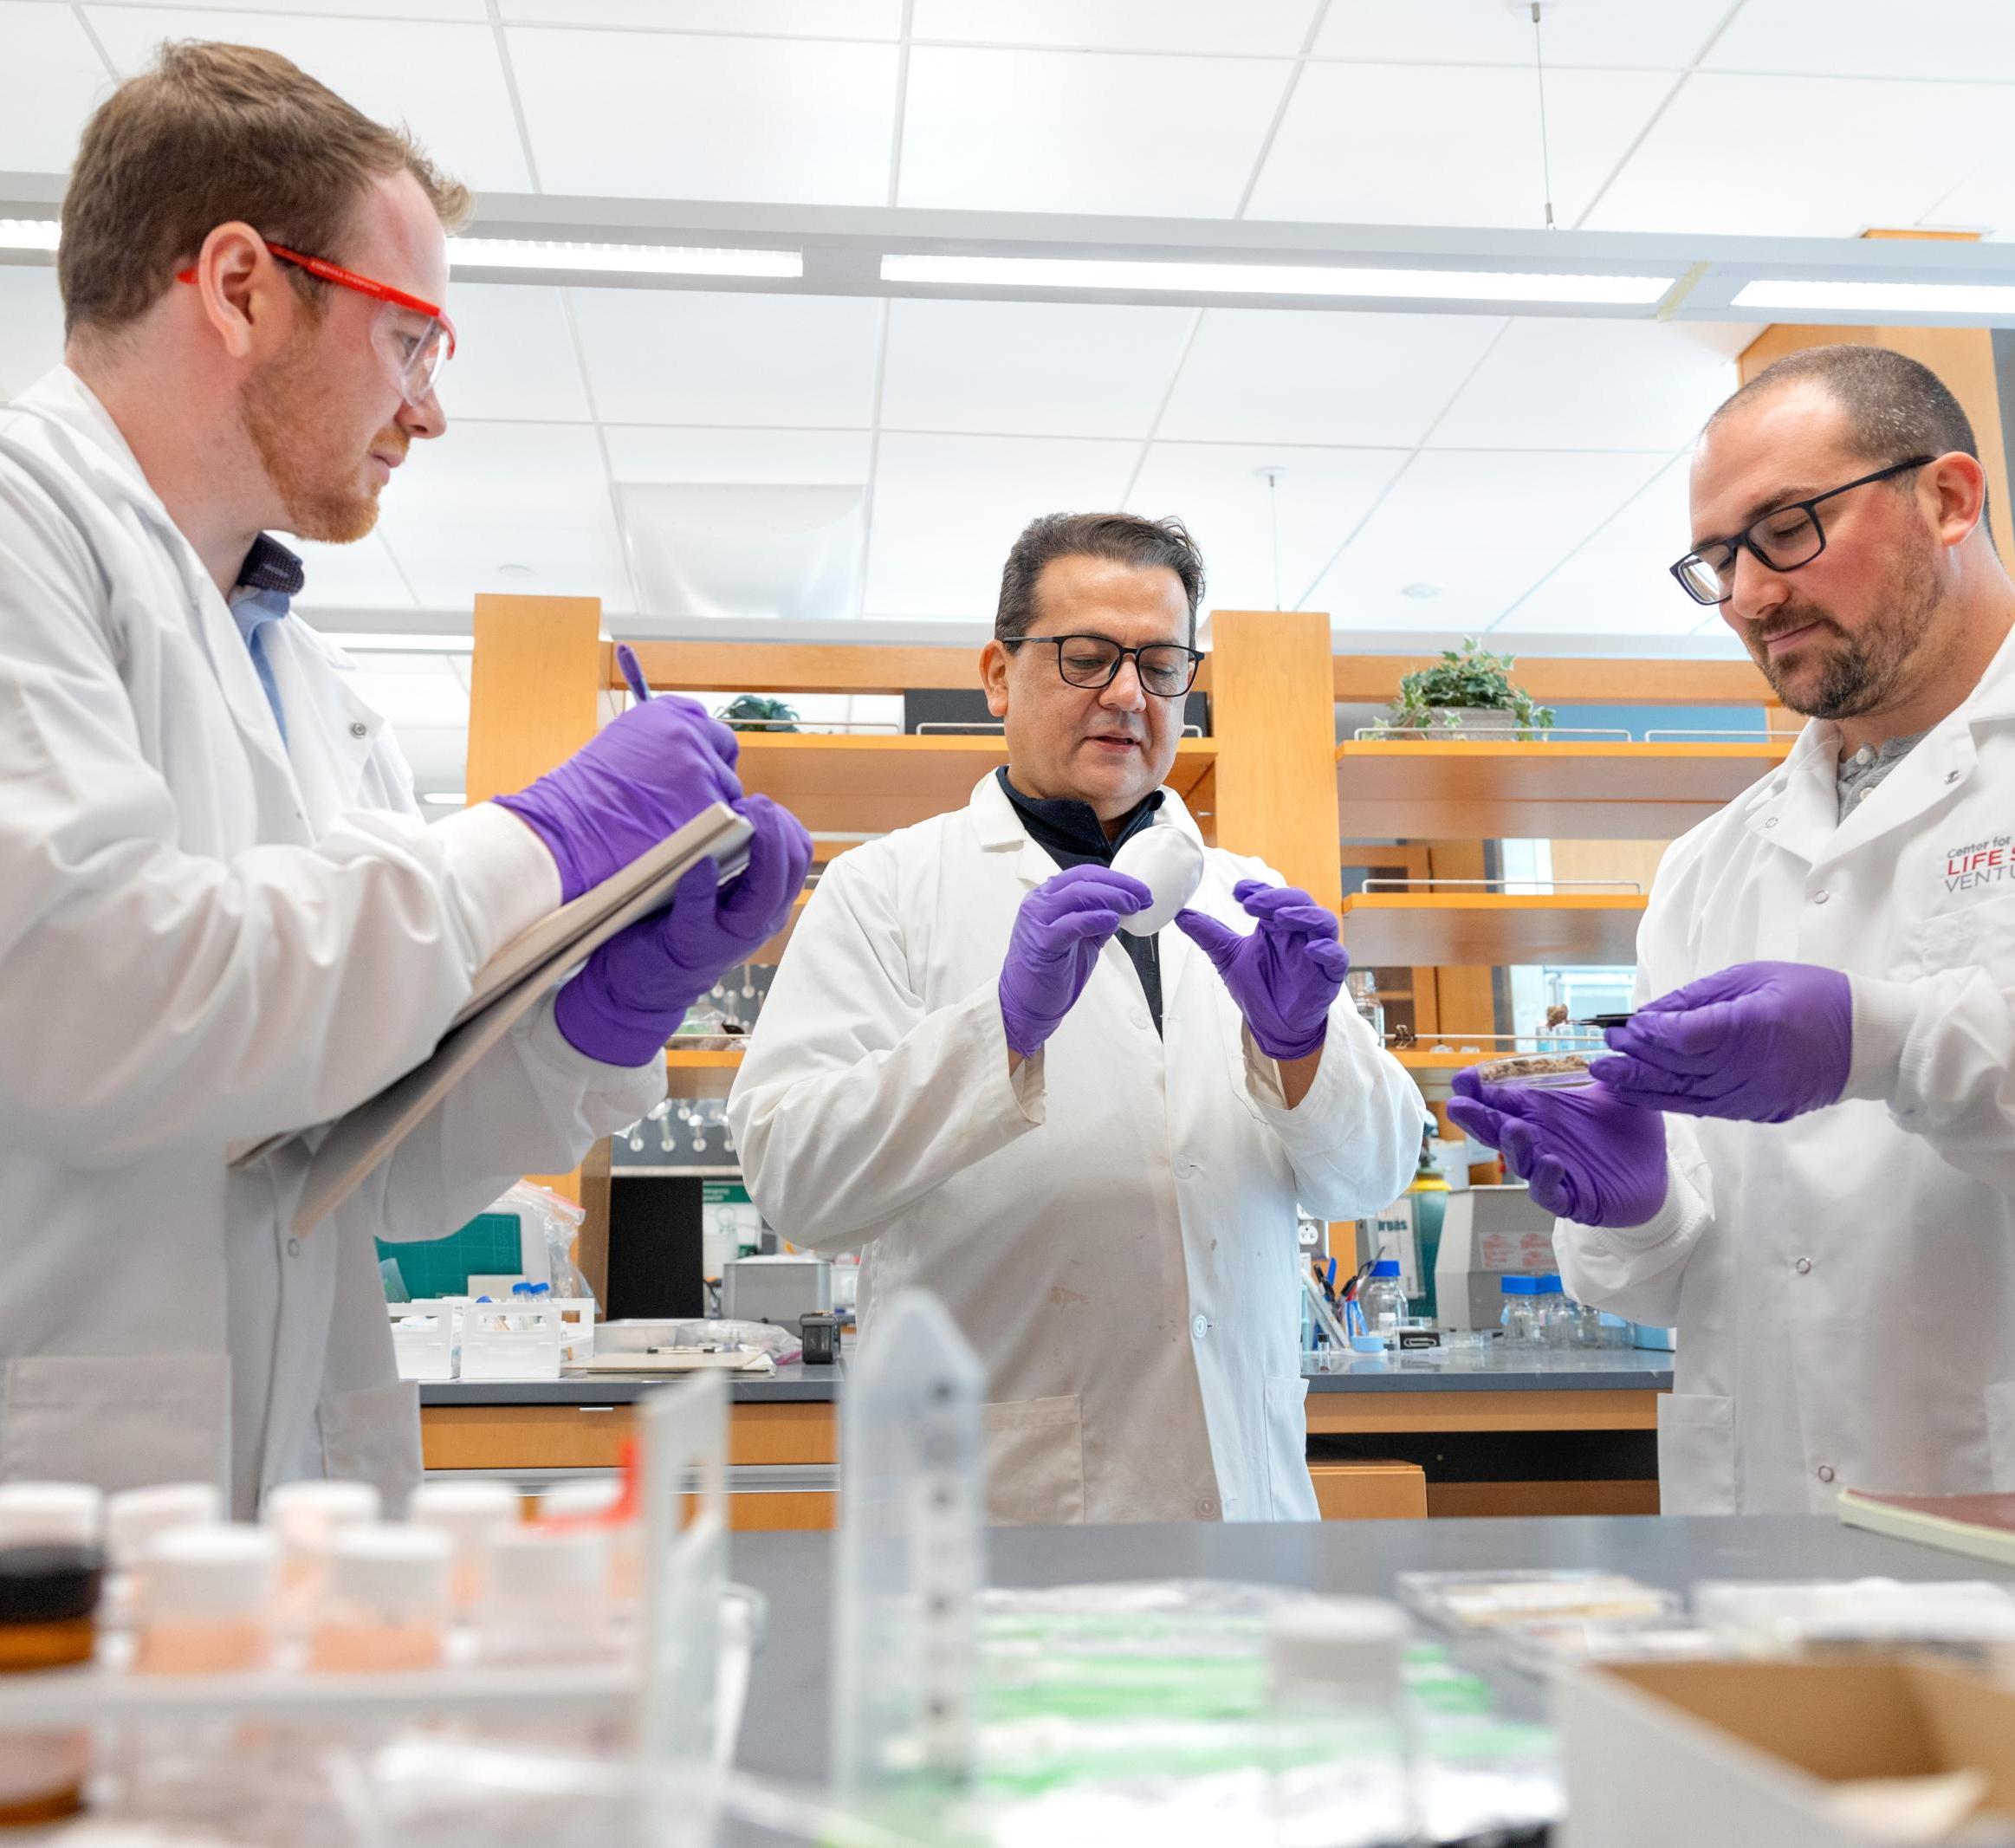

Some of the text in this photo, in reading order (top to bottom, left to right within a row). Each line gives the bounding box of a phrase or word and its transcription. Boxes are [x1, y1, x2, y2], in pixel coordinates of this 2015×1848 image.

[1947, 836, 2012, 859] Center for
[1947, 848, 2004, 876] LIFE
